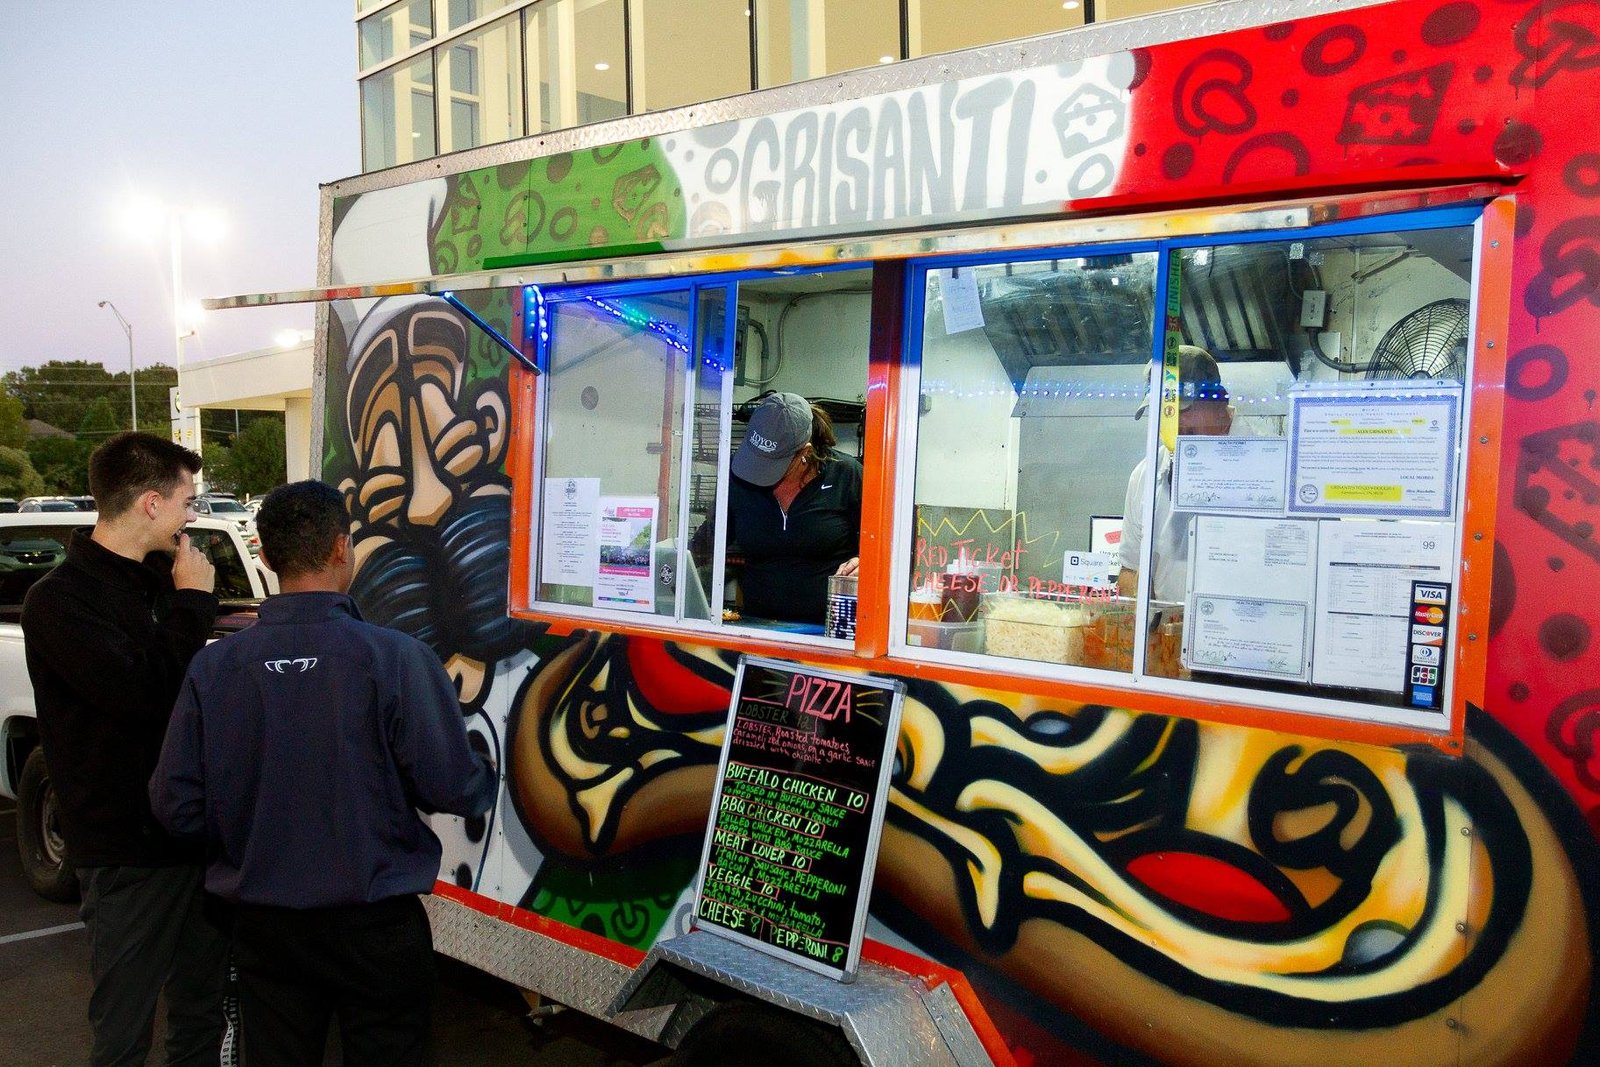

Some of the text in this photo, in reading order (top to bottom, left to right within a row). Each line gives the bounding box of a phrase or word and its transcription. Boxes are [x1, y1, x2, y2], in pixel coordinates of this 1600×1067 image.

[741, 79, 1037, 232] GRISANTI
[914, 537, 948, 567] RED
[1422, 541, 1436, 550] 99
[1080, 557, 1104, 567] Square
[913, 571, 989, 593] CHEESE
[1000, 575, 1019, 593] OR
[1420, 590, 1443, 600] VISA
[1413, 629, 1442, 637] DISCOVER
[786, 673, 852, 723] PIZZA
[739, 703, 789, 723] LOBSTER
[725, 762, 864, 808] BUFFALO CHICKEN 10
[734, 781, 847, 819] TOSSED IN BUFFALO SAUCE
[720, 795, 820, 835] BBQ CHICKEN 10
[714, 830, 807, 869] MEAT LOVER 10
[751, 831, 772, 845] WITH
[792, 833, 850, 859] MOZZARELLA
[709, 865, 773, 895] VEGGIE 10
[700, 899, 746, 928] CHEESE
[769, 924, 844, 963] PEPPERONI 8
